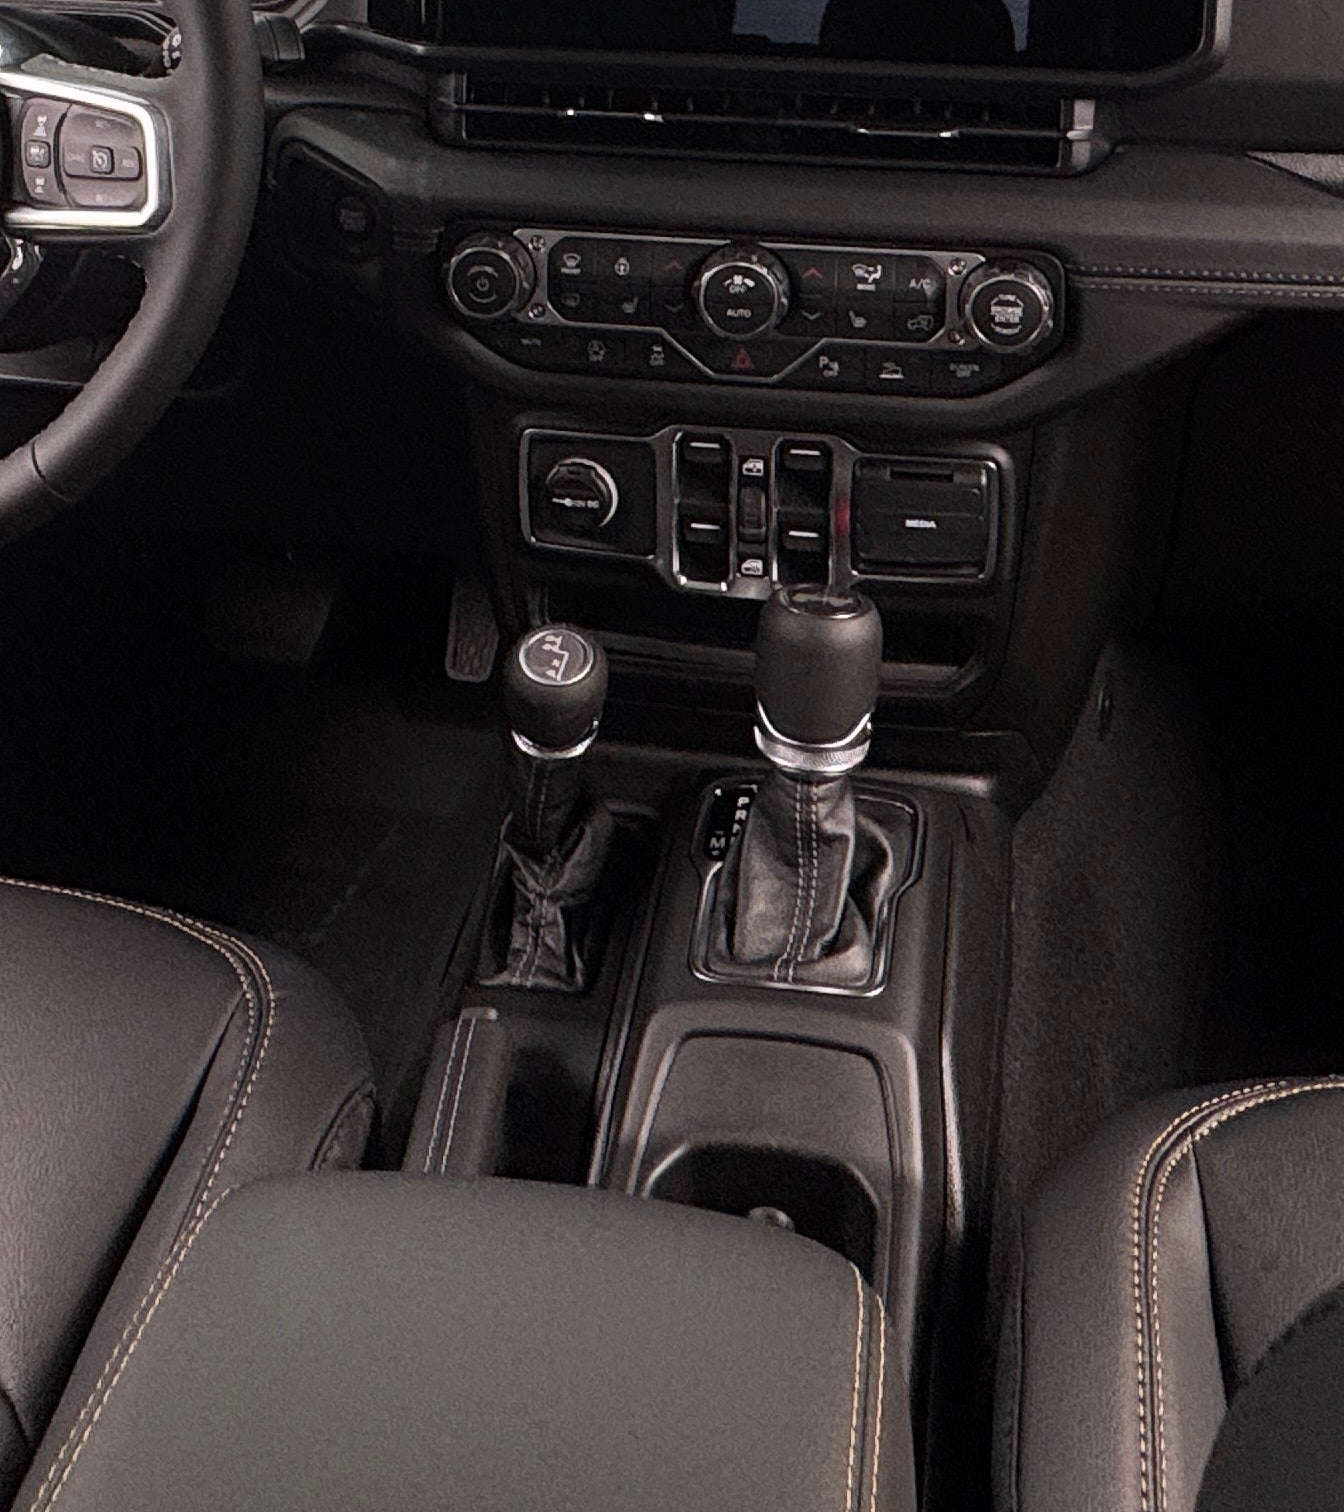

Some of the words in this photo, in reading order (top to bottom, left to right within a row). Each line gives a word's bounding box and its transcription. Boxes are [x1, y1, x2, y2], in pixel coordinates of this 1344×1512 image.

[726, 308, 752, 319] AUTO
[904, 518, 937, 530] MEDIA
[737, 796, 750, 808] P
[734, 809, 748, 821] R
[709, 836, 726, 849] M
